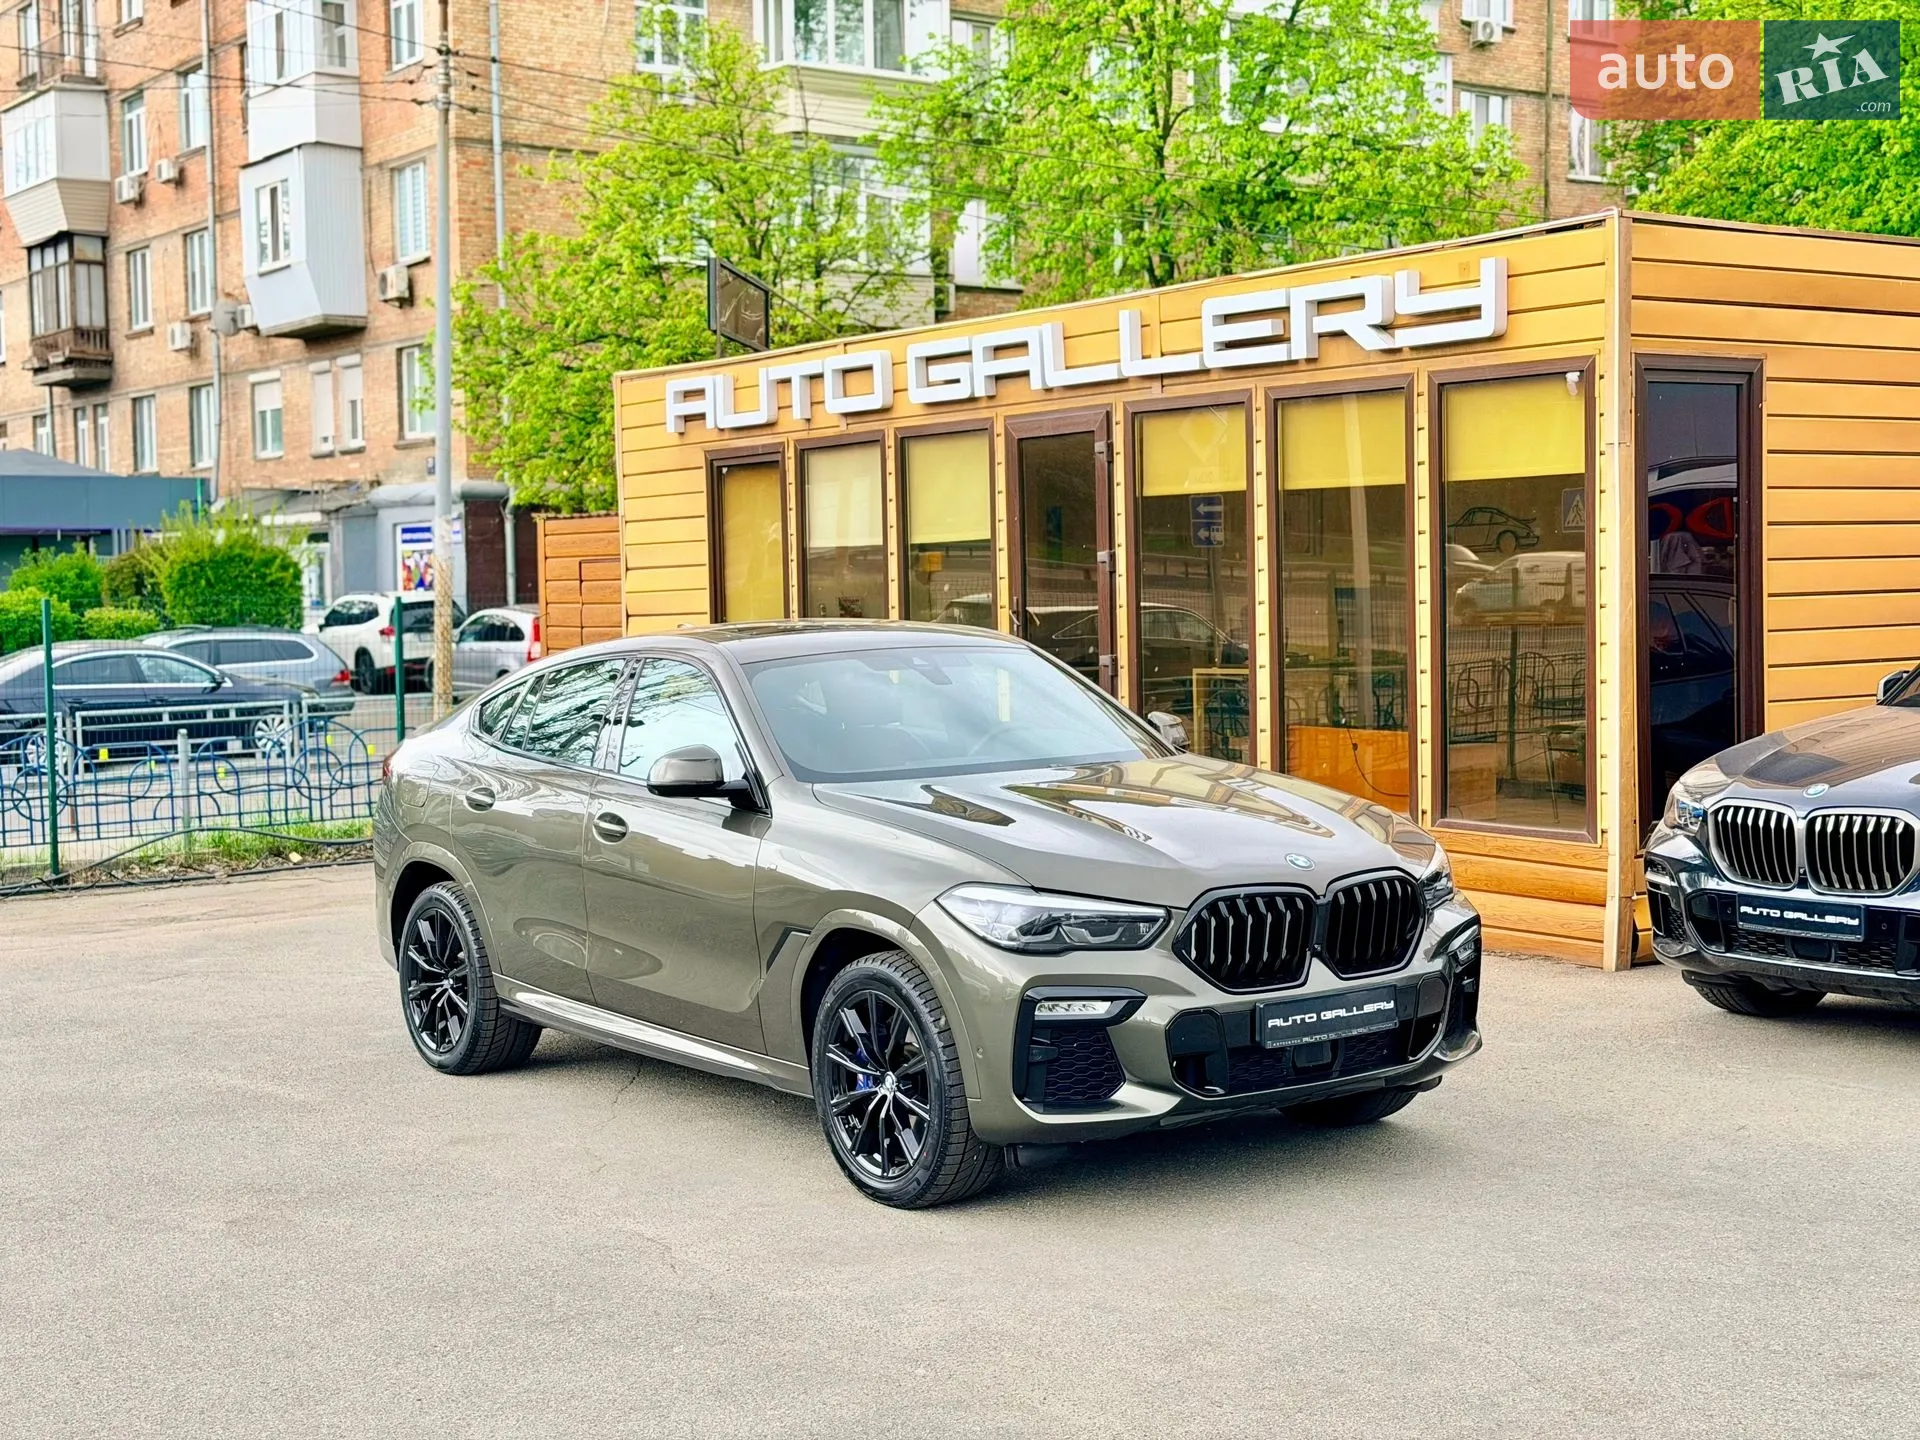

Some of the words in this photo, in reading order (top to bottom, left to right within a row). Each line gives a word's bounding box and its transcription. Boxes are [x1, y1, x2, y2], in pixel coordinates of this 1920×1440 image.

[665, 350, 894, 434] AUTO
[906, 256, 1509, 404] GALLERY
[1740, 906, 1780, 917] AUTO
[1783, 911, 1859, 926] GALLERY
[1267, 1012, 1317, 1028] AUTO
[1321, 1000, 1395, 1020] GALLERY
